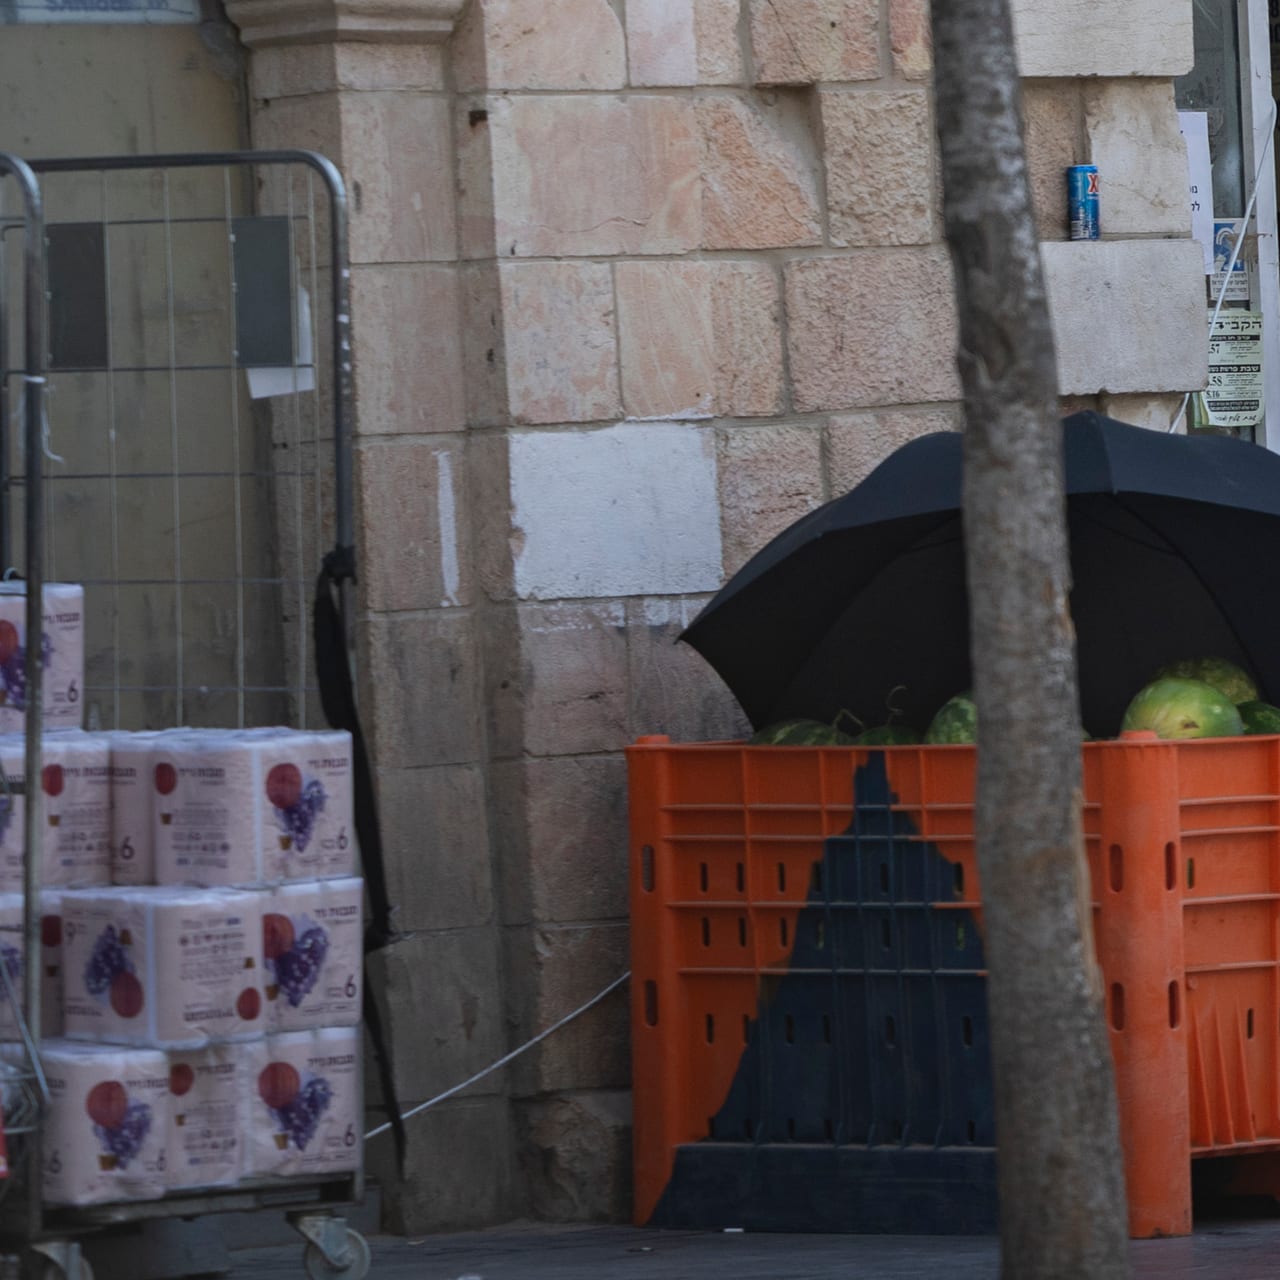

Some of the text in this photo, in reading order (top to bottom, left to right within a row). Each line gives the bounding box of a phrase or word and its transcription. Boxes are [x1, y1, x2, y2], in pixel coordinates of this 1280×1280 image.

[67, 680, 79, 703] 6
[120, 836, 134, 861] 6
[336, 826, 349, 850] 6
[345, 975, 358, 999] 6
[345, 1127, 356, 1149] 6
